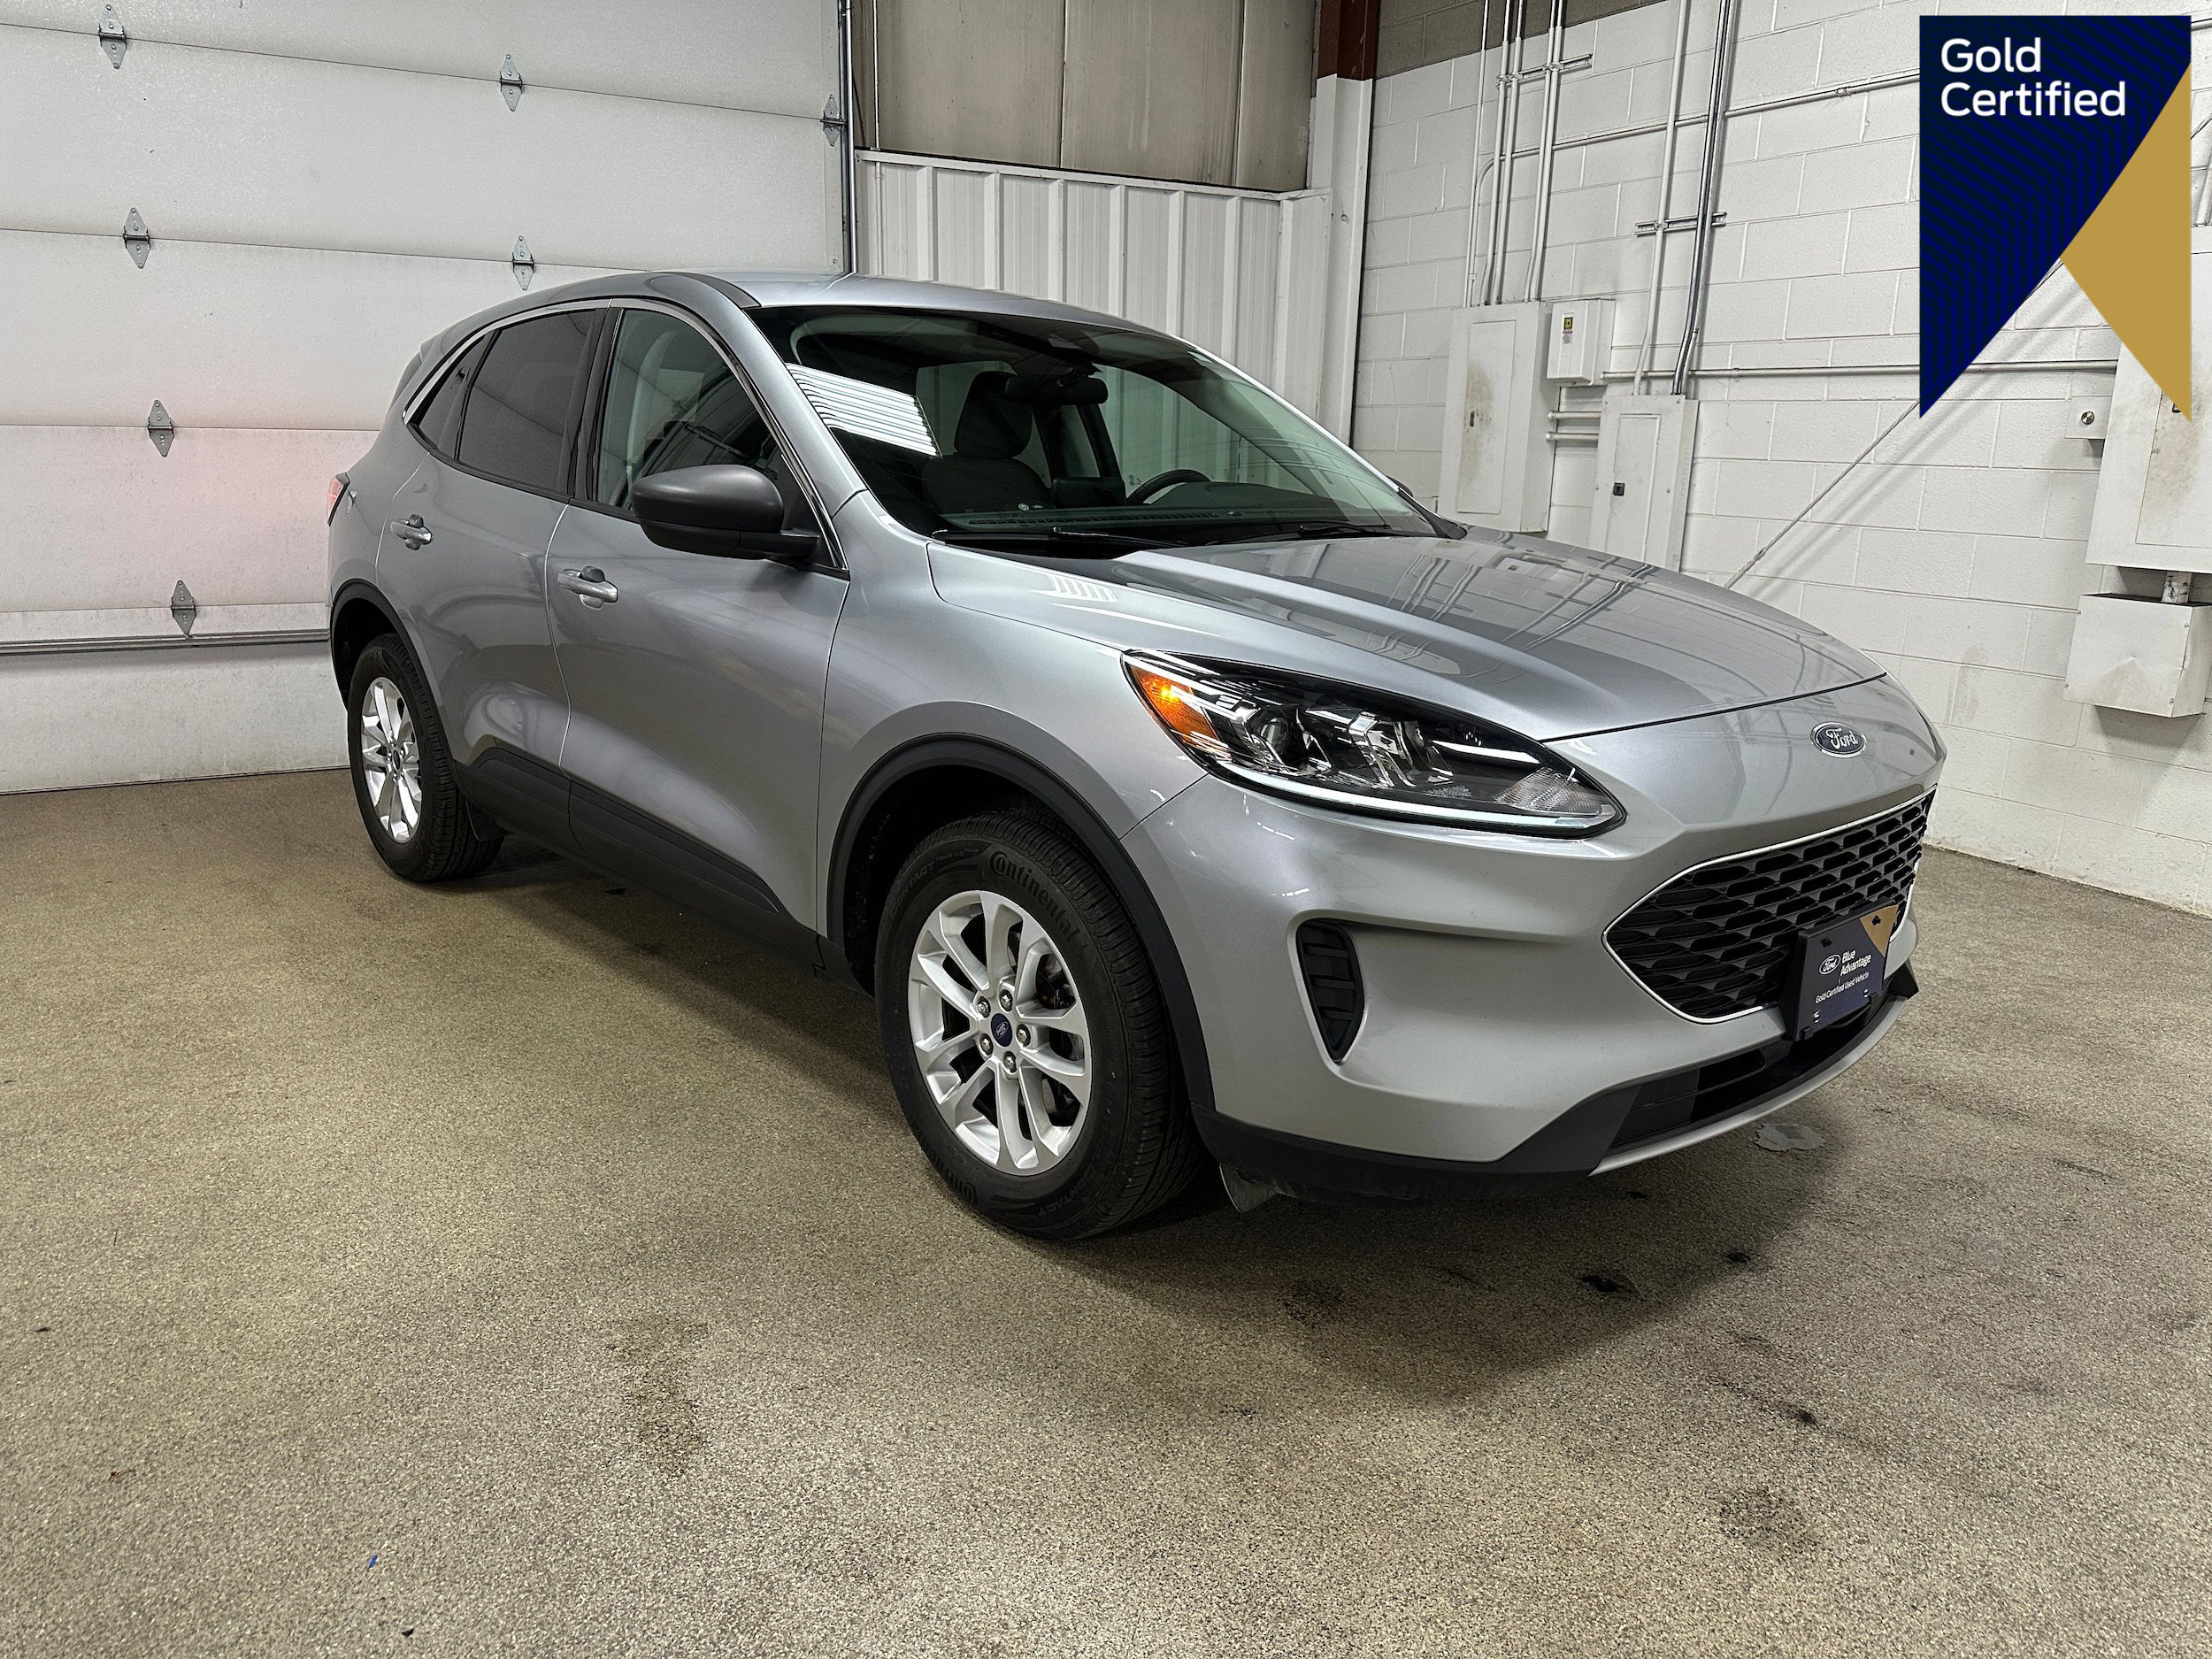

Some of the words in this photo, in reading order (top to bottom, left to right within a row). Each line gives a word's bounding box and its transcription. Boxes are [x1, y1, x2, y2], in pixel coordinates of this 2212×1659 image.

[989, 850, 1081, 943] Continental
[1839, 954, 1872, 977] Advantage
[1841, 949, 1856, 964] Blue
[1815, 993, 1827, 1004] Gold
[1826, 983, 1845, 999] Certified
[1844, 978, 1855, 990] Used
[1855, 971, 1870, 984] Vehicle
